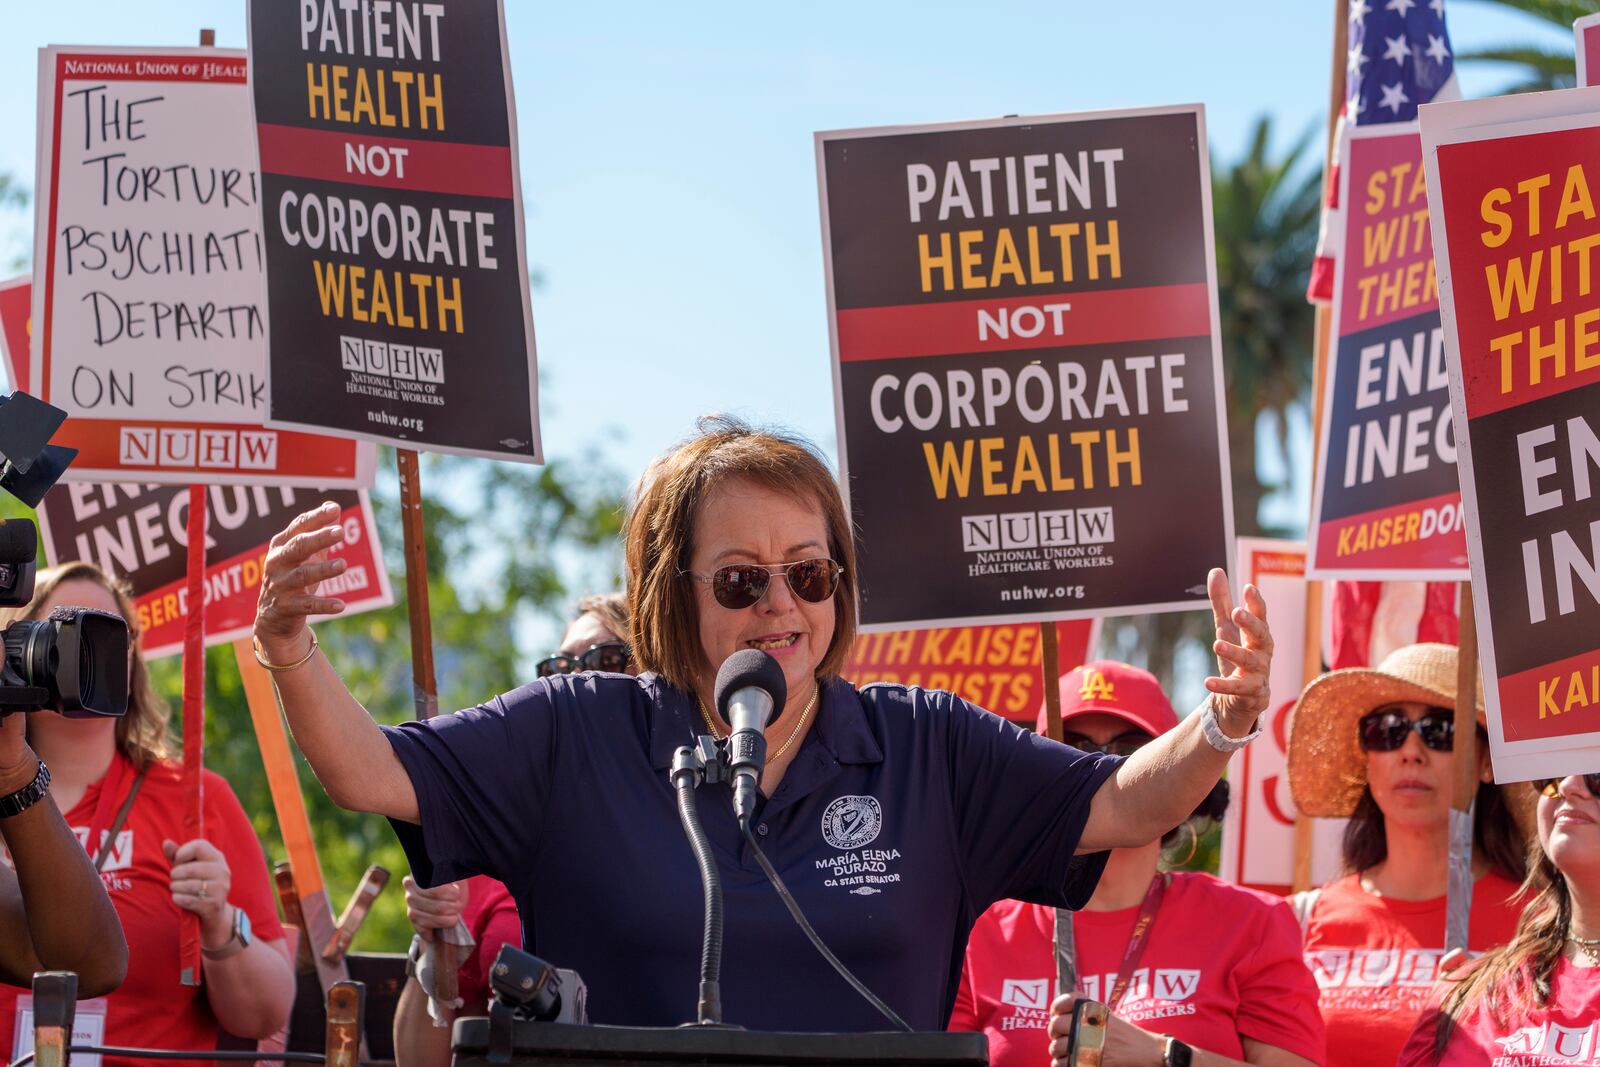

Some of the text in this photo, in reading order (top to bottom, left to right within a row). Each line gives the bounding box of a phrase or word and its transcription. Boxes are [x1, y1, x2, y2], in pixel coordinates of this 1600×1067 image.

[300, 0, 445, 62] PATIENT
[65, 60, 131, 75] NATIONAL
[135, 62, 178, 75] UNION
[182, 64, 198, 76] OF
[306, 62, 445, 131] HEALTH
[67, 85, 164, 150] THE
[345, 142, 408, 178] NOT
[907, 148, 1124, 222] PATIENT
[1480, 164, 1596, 248] STA
[279, 190, 498, 270] CORPORATE
[918, 219, 1122, 292] HEALTH
[1485, 233, 1600, 321] WIT
[313, 260, 464, 333] WEALTH
[977, 303, 1071, 341] NOT
[343, 340, 441, 378] NUHW
[1490, 308, 1600, 395] THE
[72, 365, 134, 409] ON
[346, 382, 445, 406] HEALTHCARE WORKERS
[351, 372, 437, 394] NATIONAL UNION OF
[870, 353, 1189, 434] CORPORATE
[368, 410, 424, 432] nuhw.org
[124, 431, 275, 464] NUHW
[922, 427, 1142, 500] WEALTH
[966, 511, 1110, 547] NUHW
[968, 556, 1114, 577] HEALTHCARE WORKERS
[977, 545, 1104, 565] NATIONAL UNION OF
[1000, 585, 1085, 601] nuhw.org
[1538, 664, 1600, 720] KAI
[815, 848, 901, 869] MARÍA ELENA
[833, 861, 887, 876] DURAZO
[824, 873, 901, 887] CA STATE SENATOR
